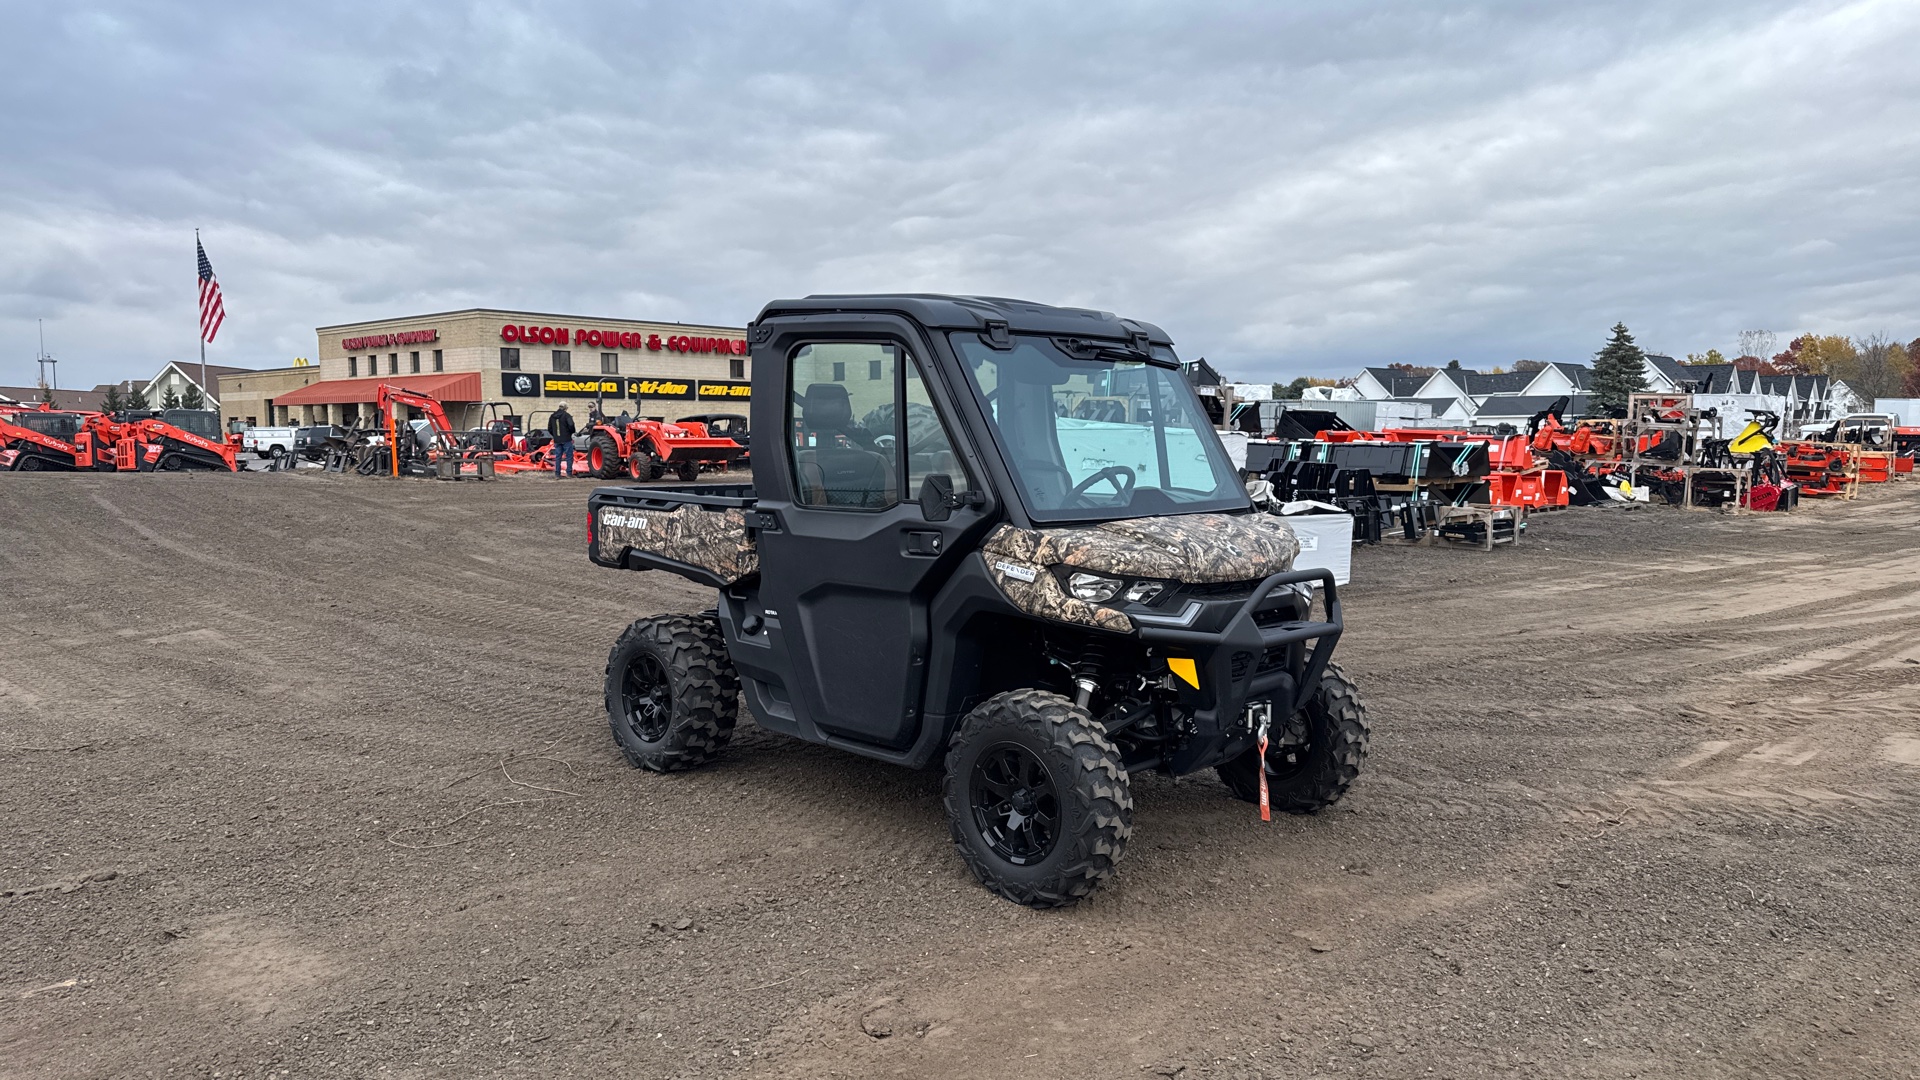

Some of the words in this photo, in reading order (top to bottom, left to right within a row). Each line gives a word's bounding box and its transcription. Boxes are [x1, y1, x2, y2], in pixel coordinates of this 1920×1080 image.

[501, 324, 569, 345] OLSON
[575, 329, 641, 349] POWER
[648, 334, 662, 350] &
[667, 335, 748, 355] EQUIPMEN
[43, 436, 68, 451] Kubota
[184, 433, 209, 448] Kubota
[603, 513, 648, 530] can-am
[996, 562, 1035, 577] DEFENDER
